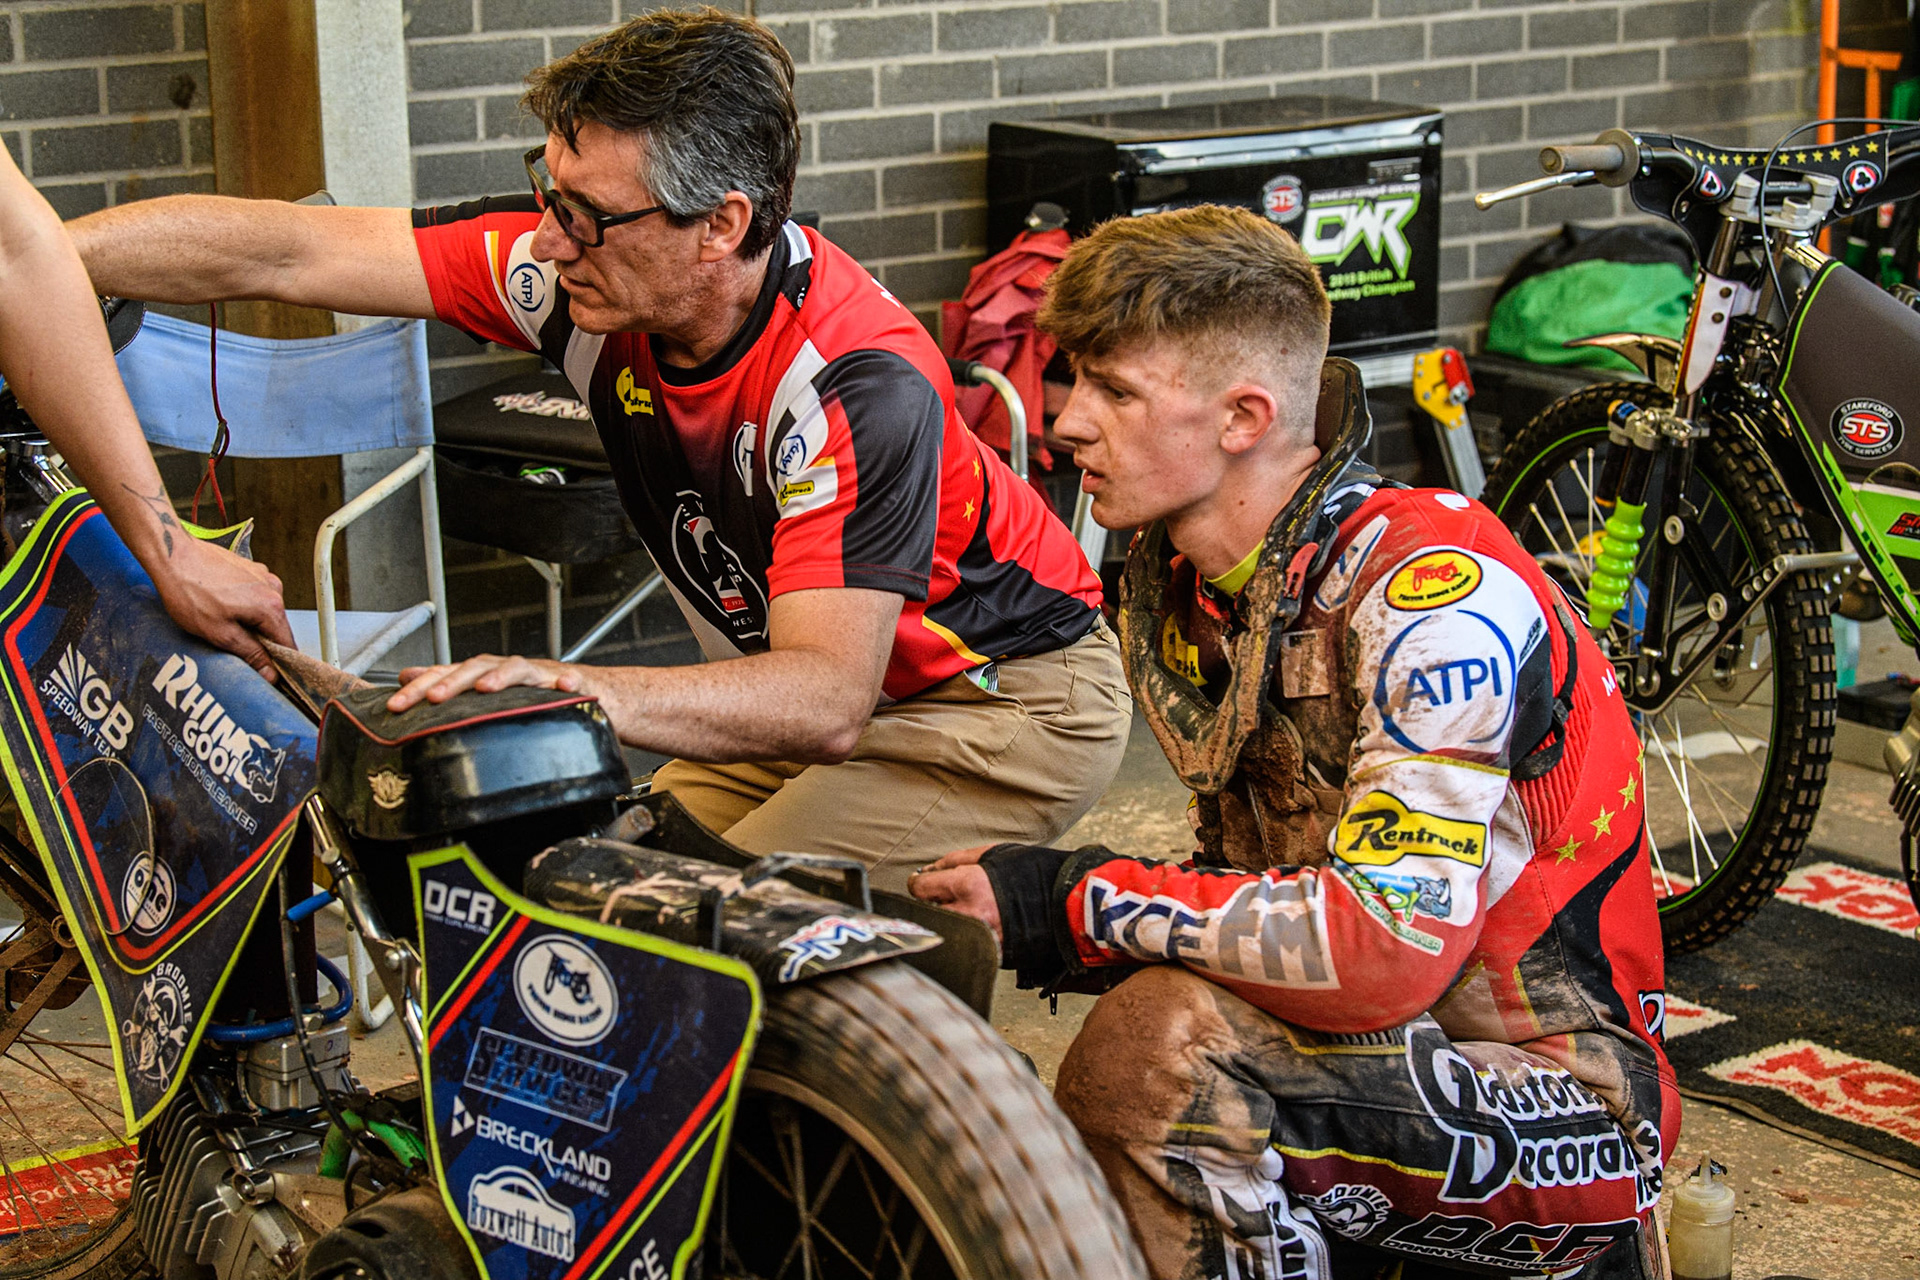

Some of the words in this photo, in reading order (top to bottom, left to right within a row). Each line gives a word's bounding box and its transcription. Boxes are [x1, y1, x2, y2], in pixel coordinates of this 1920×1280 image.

[1302, 193, 1420, 280] CWR
[521, 271, 533, 304] ATPI
[1841, 401, 1894, 420] STAKEFORD
[1842, 417, 1890, 439] STS
[1854, 442, 1893, 456] SERVICES
[39, 680, 95, 738] SPEEDWAY
[1401, 656, 1503, 713] ATPI
[80, 678, 134, 750] GB
[142, 704, 172, 737] FAST
[167, 734, 206, 783] ACTION
[203, 776, 258, 836] CLEANER
[183, 719, 239, 783] GOO!
[1347, 808, 1479, 857] Rentruck
[424, 879, 497, 927] DCR
[156, 962, 193, 1023] BROOMIE
[476, 1115, 611, 1182] BRECKLAND
[1385, 1239, 1463, 1260] DANNY
[1461, 1252, 1522, 1270] CURL
